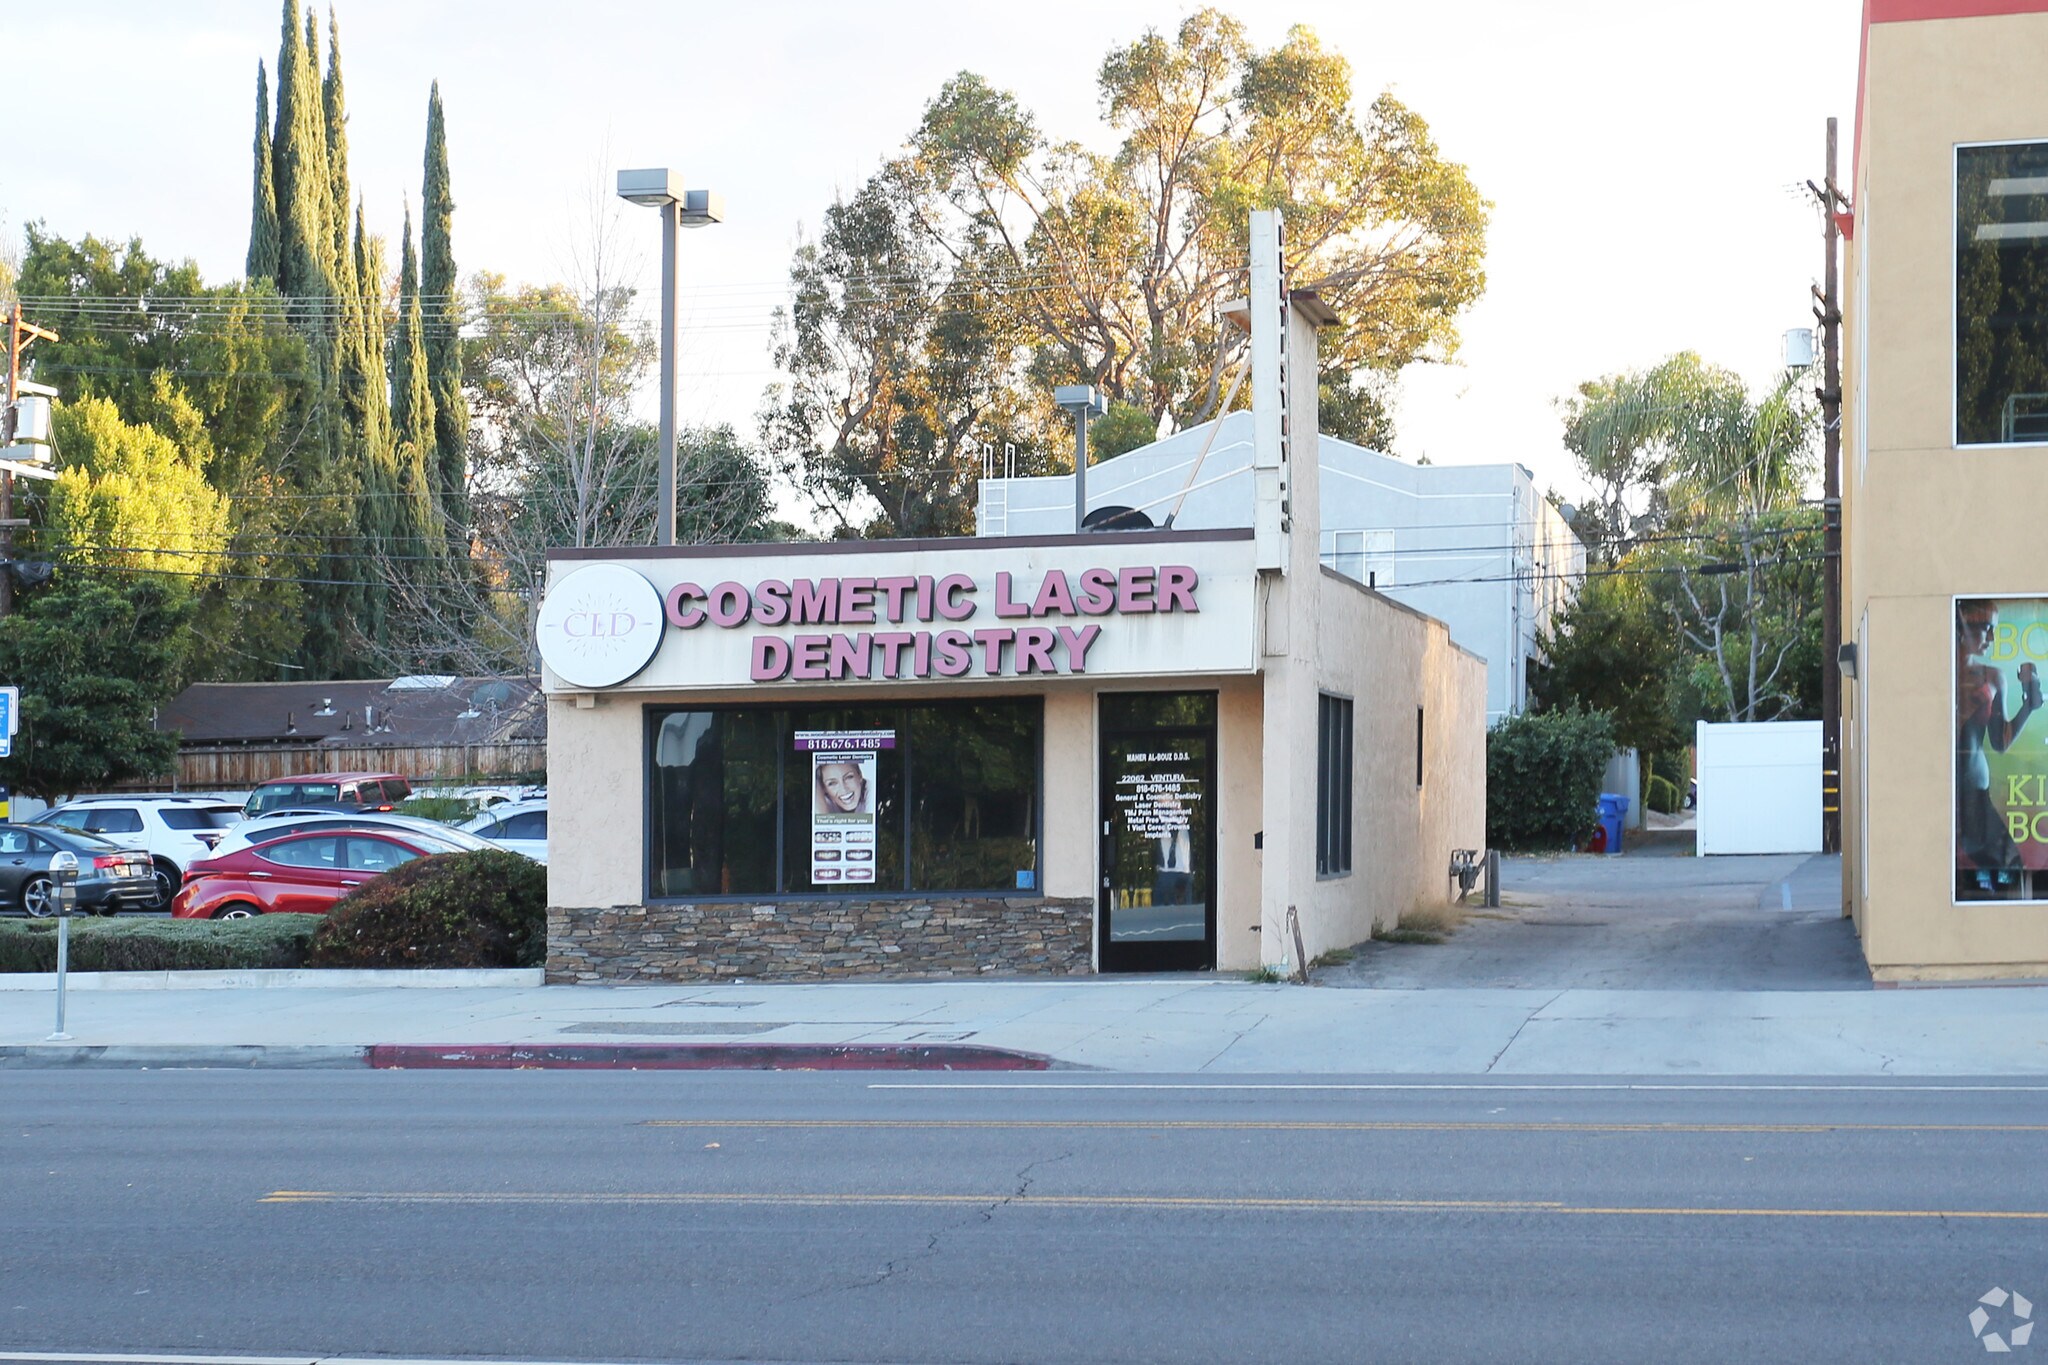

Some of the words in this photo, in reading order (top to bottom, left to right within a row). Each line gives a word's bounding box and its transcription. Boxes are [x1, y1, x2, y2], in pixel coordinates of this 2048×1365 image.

[666, 573, 977, 629] COSMETIC
[995, 566, 1200, 618] LASER
[750, 624, 1102, 682] DENTISTRY
[807, 738, 881, 749] 818.676.1485
[1126, 753, 1147, 762] MAHER
[1121, 774, 1145, 783] 22062
[1150, 773, 1186, 782] VENTURA
[1115, 794, 1138, 802] General
[1146, 793, 1173, 801] Cosmetic
[1174, 792, 1202, 801] Dentistry
[1134, 801, 1152, 809] Laser
[1153, 801, 1182, 809] Dentistry
[1153, 808, 1192, 816] Management
[1127, 816, 1144, 824] Metal
